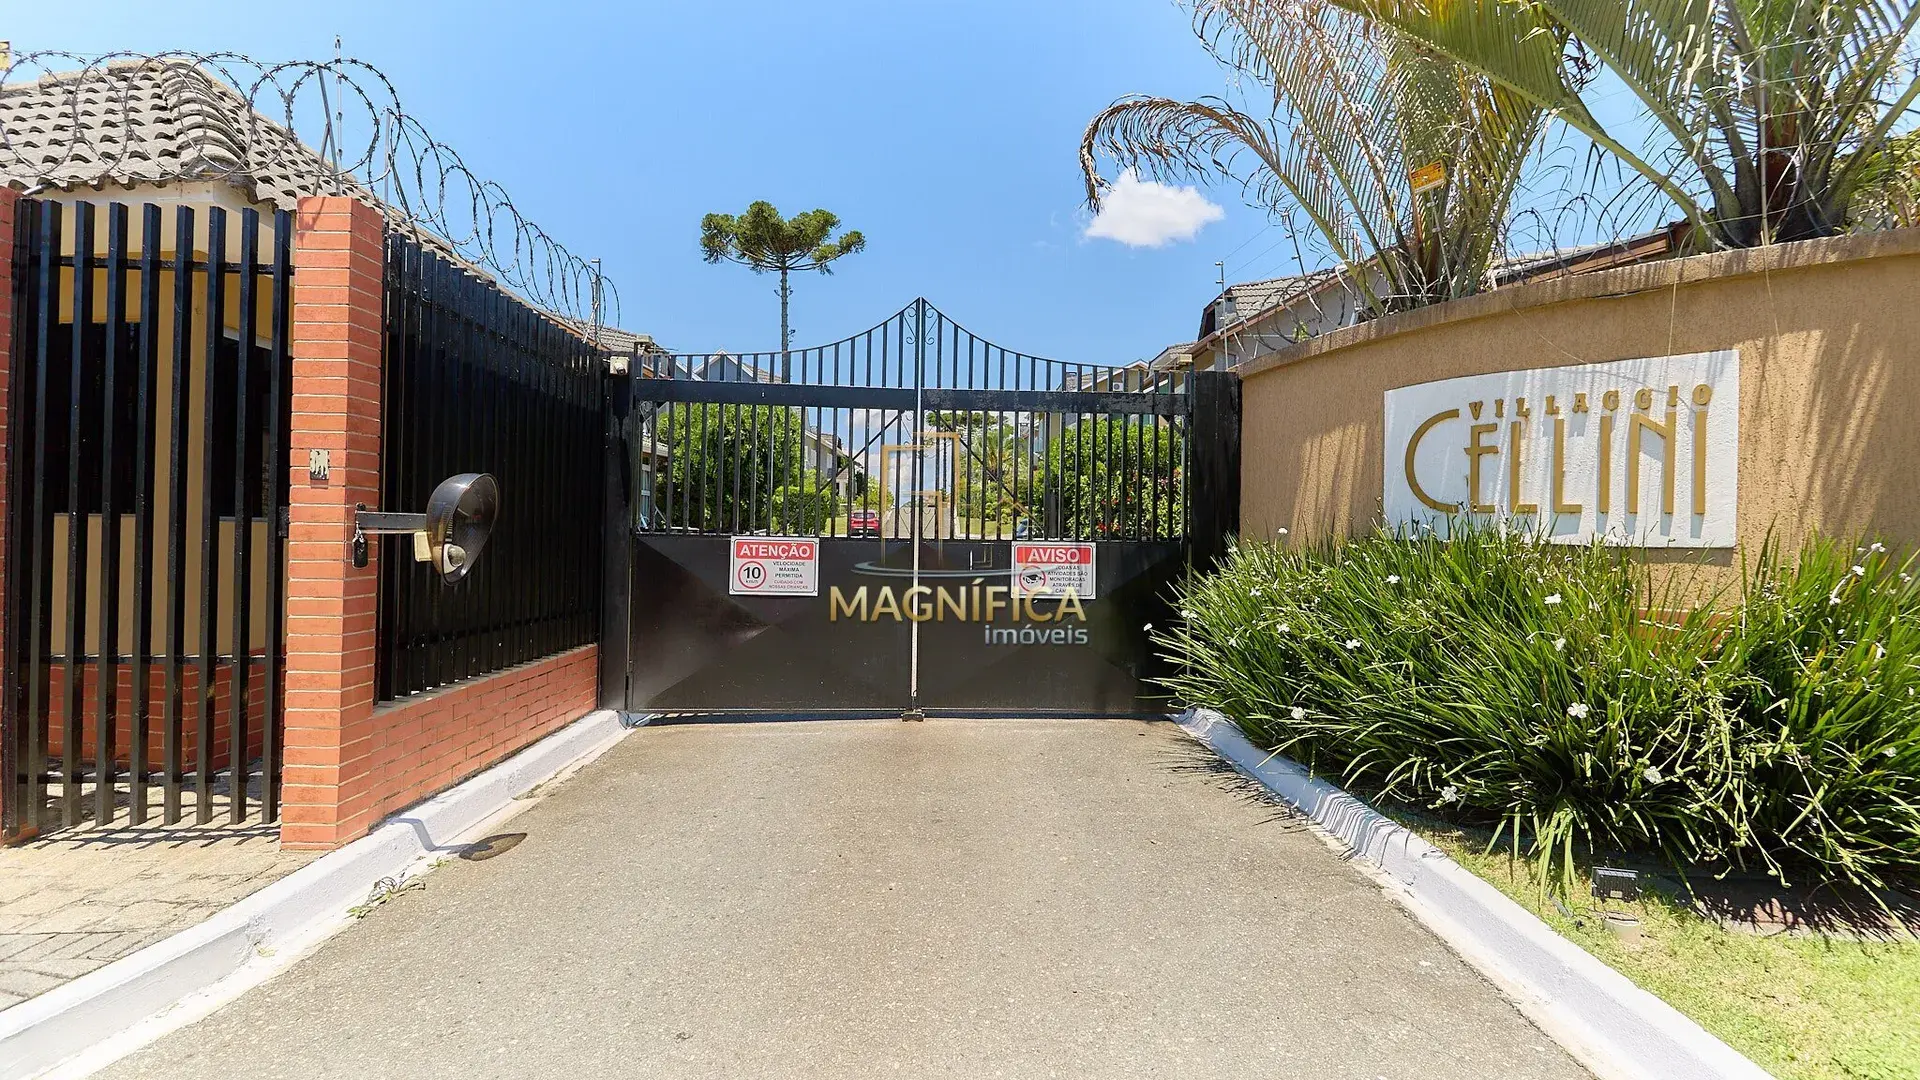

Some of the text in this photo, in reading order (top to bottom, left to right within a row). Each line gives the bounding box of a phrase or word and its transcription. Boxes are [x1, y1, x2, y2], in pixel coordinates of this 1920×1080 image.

[1469, 383, 1712, 420] VILLAGGIO
[1405, 409, 1706, 515] CELLINI
[740, 543, 810, 559] ATENÇÃO
[1028, 548, 1080, 563] AVISO
[743, 566, 761, 579] 10
